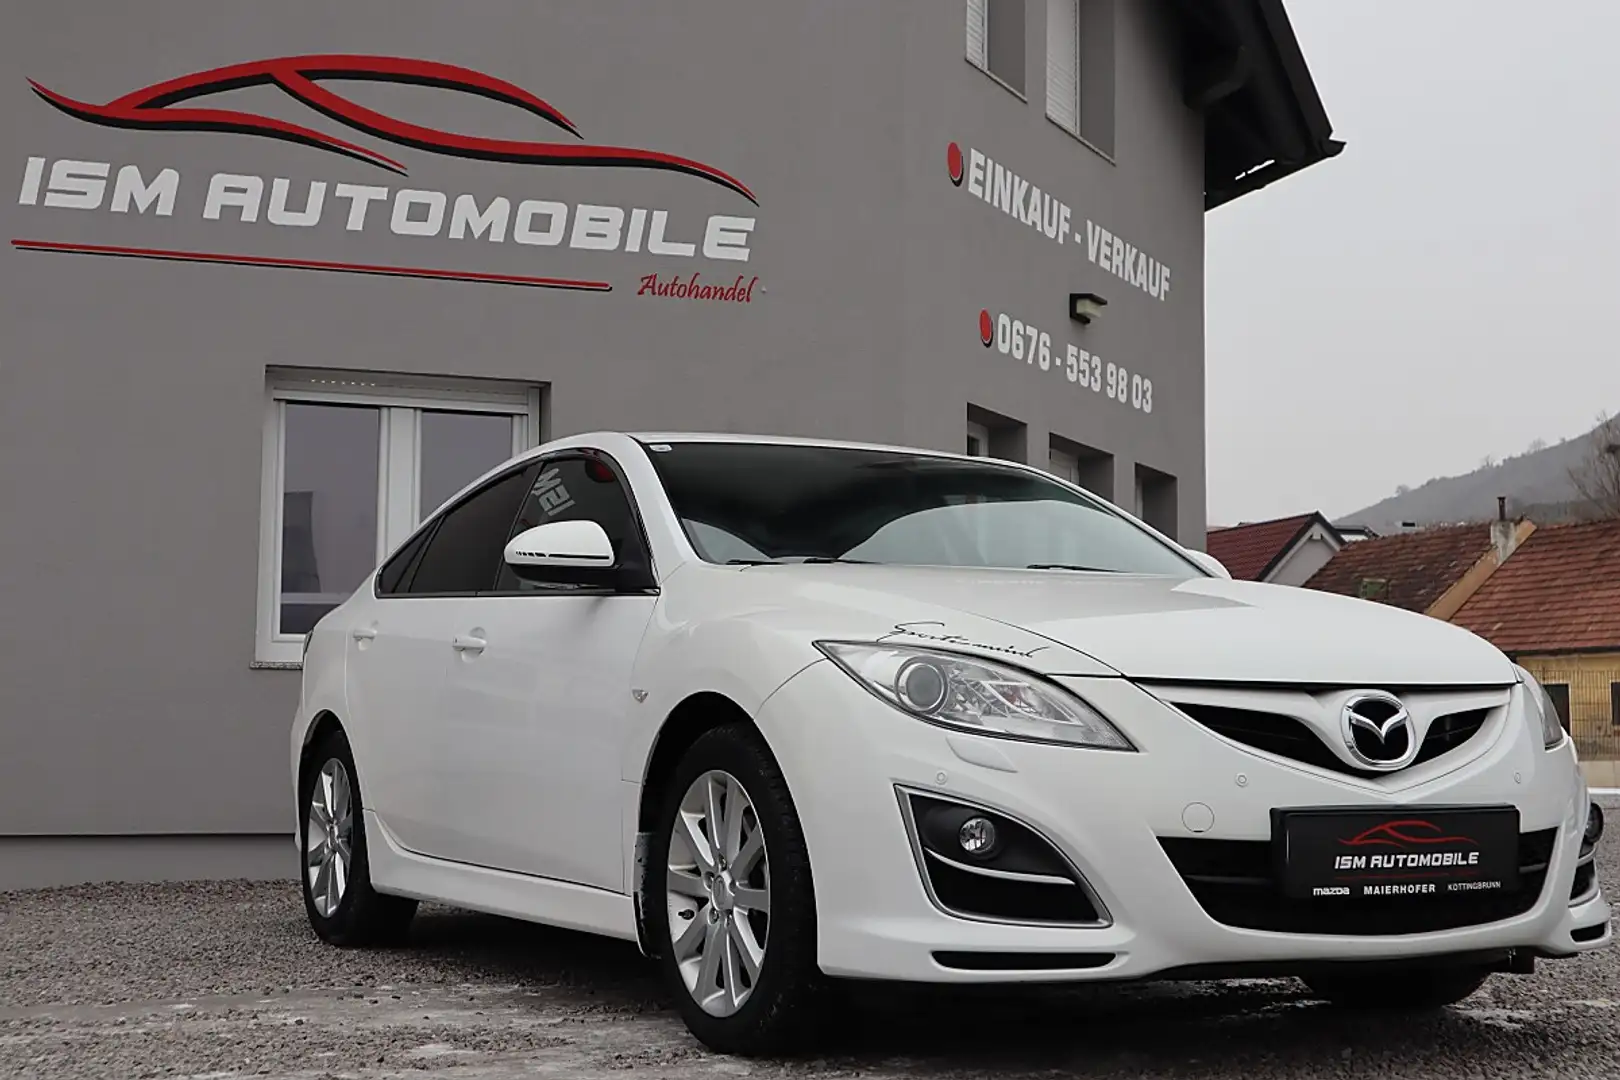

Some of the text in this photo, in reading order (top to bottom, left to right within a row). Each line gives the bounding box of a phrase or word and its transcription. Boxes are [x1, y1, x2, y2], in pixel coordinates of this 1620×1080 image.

[18, 156, 756, 262] ISM AUTOMOBILE
[968, 147, 1071, 245] EINKAUF
[1086, 219, 1171, 301] VERKAUF
[636, 272, 759, 303] Autohandel
[997, 313, 1051, 371] 0676
[1066, 343, 1101, 393] 553
[1106, 362, 1128, 404] 98
[1131, 374, 1153, 413] 03
[1334, 851, 1480, 870] ISM AUTOMOBILE
[1363, 884, 1436, 896] MAIERHOFER
